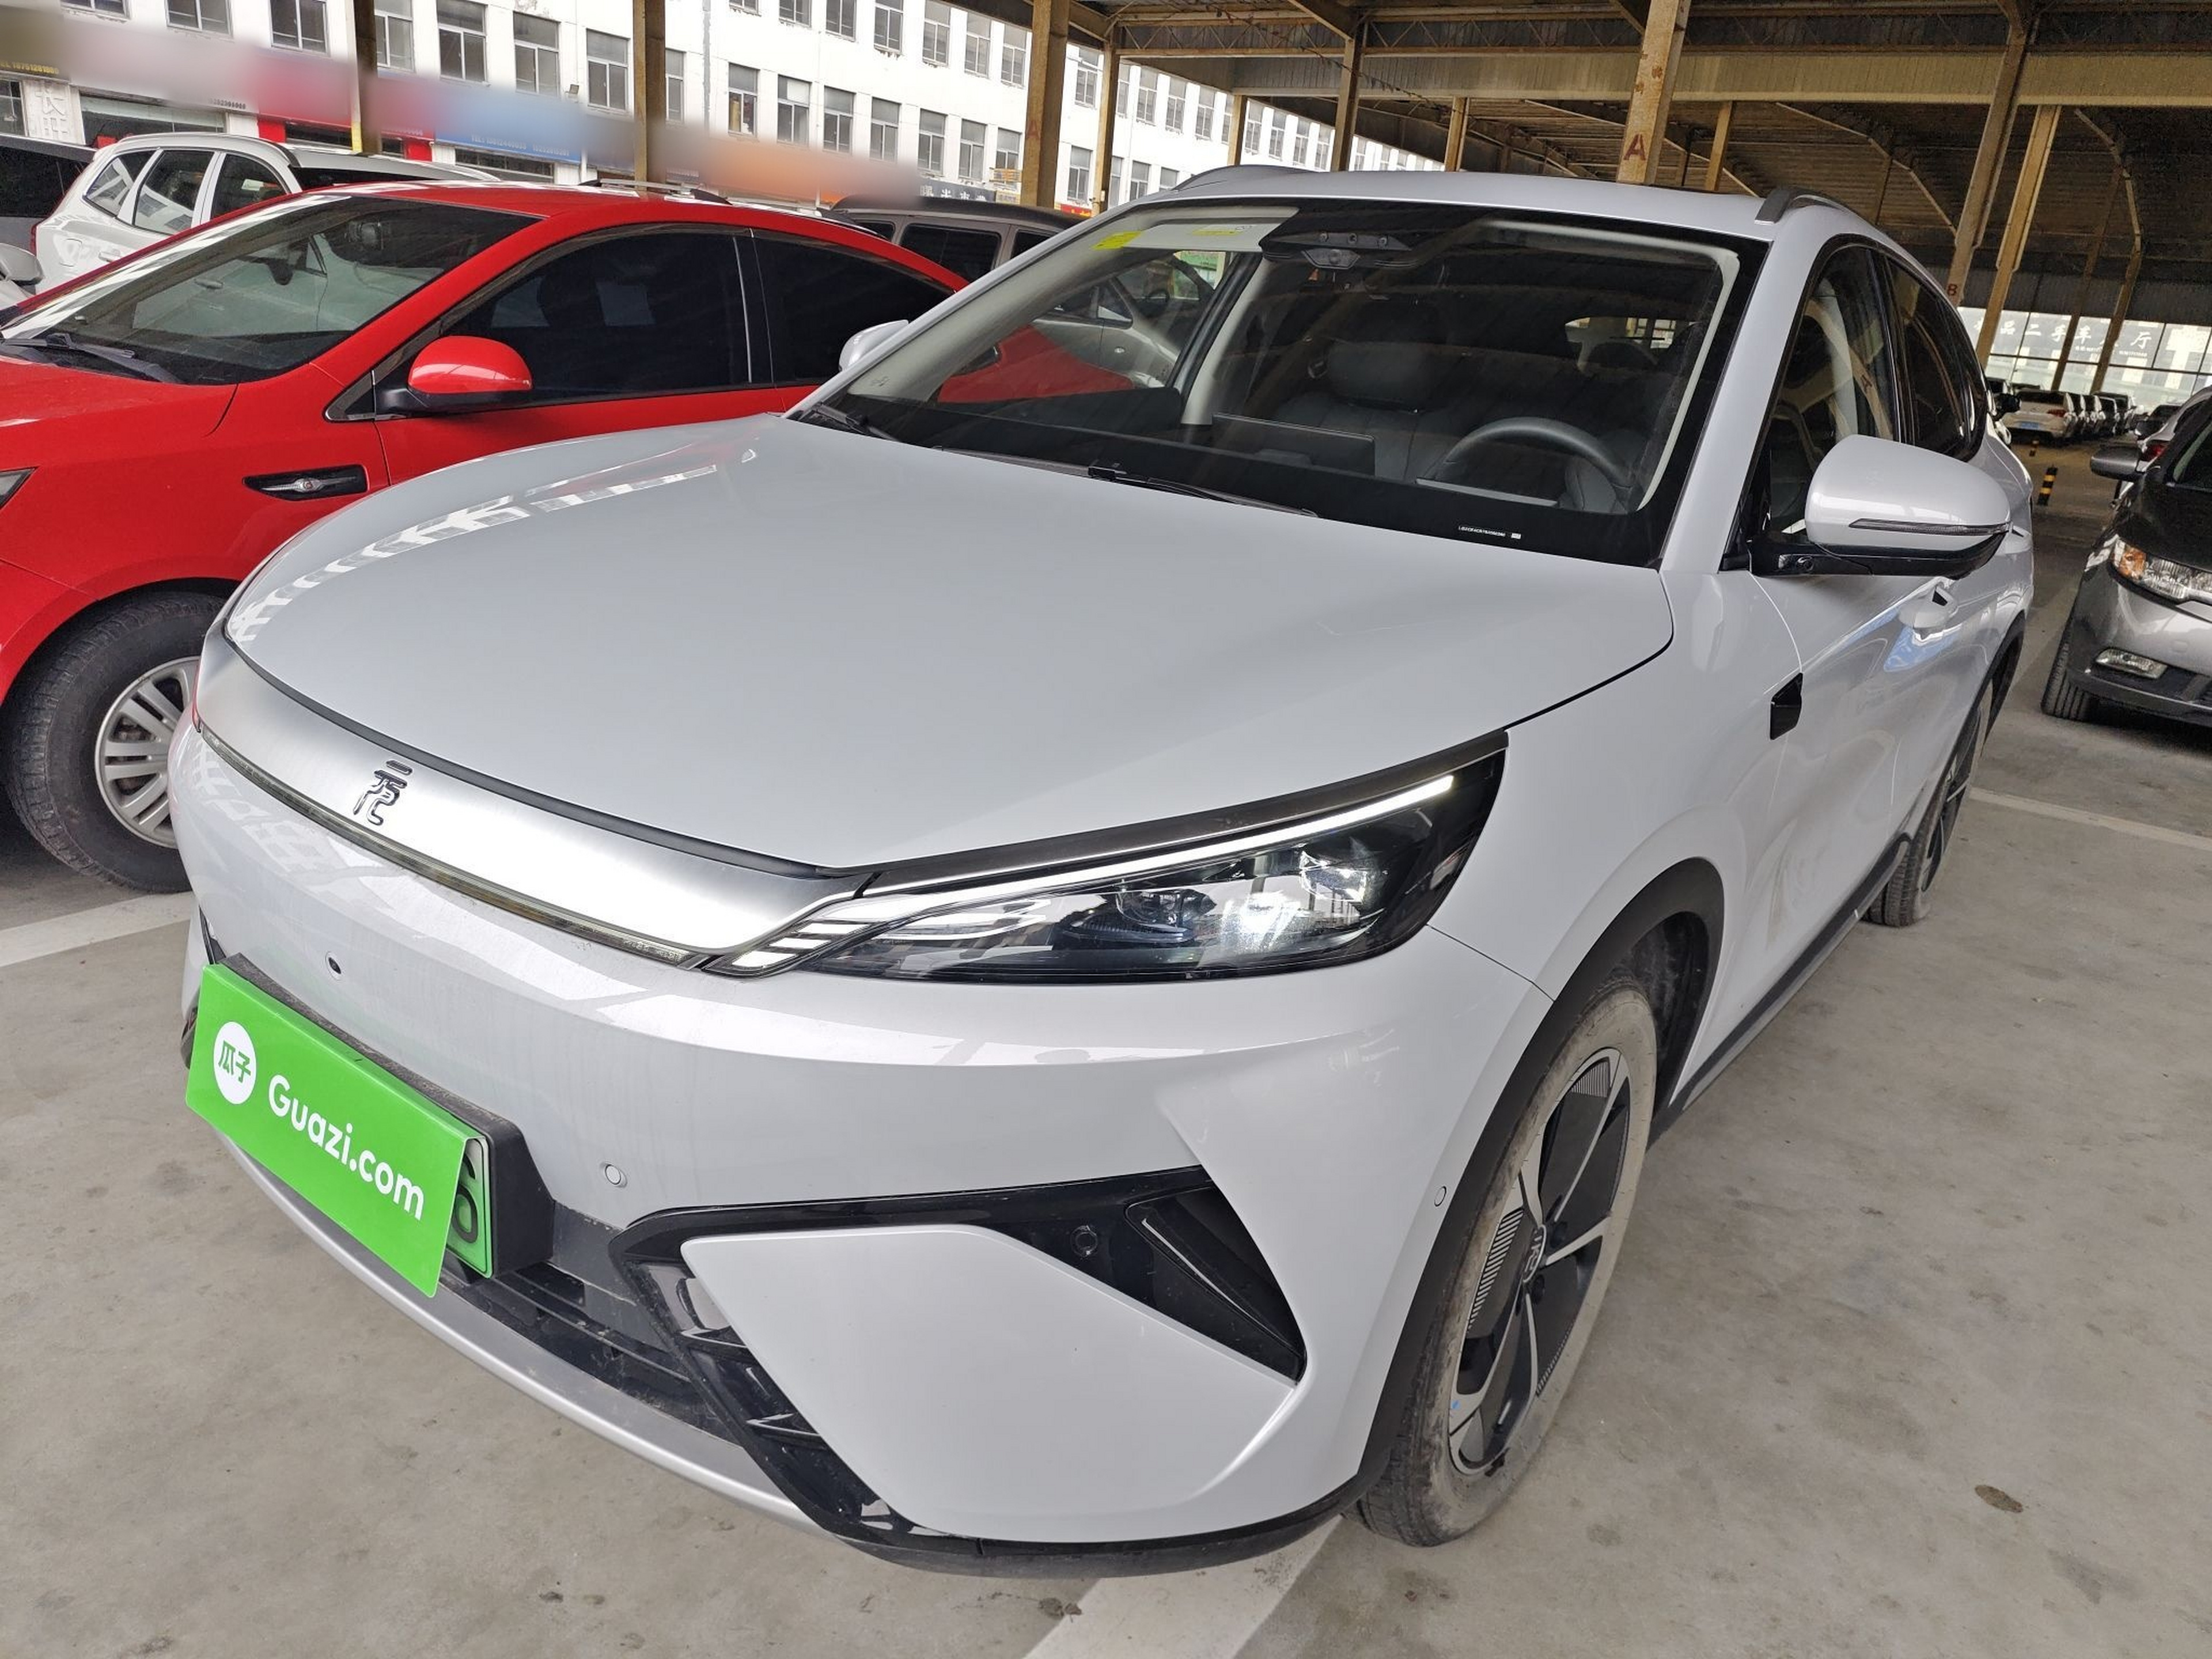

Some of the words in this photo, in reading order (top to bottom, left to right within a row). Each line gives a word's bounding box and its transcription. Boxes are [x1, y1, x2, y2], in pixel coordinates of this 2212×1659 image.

[1027, 120, 1040, 140] A
[1623, 133, 1647, 160] A
[1948, 283, 1958, 296] B
[353, 760, 413, 826] 元
[218, 1040, 252, 1084] 瓜子
[268, 1074, 425, 1221] Guazi.com
